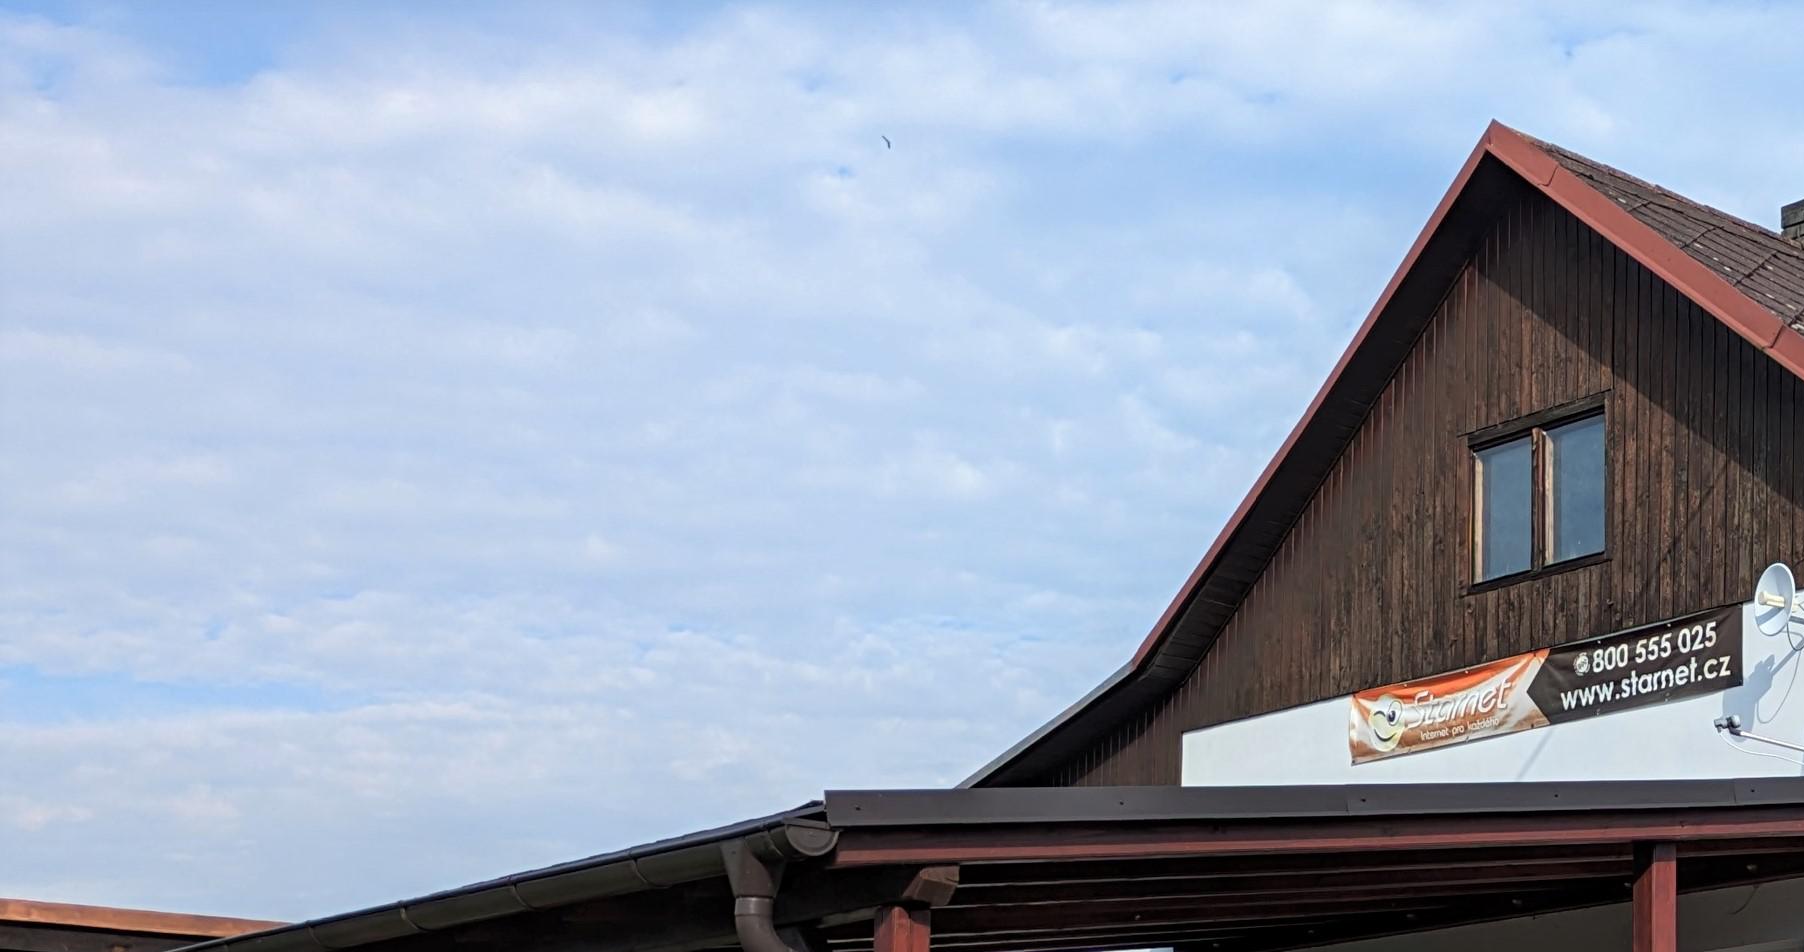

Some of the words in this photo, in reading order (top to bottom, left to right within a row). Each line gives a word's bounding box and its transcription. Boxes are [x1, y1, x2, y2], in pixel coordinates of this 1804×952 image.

[1592, 643, 1628, 674] 800
[1635, 632, 1672, 664] 555
[1677, 621, 1717, 654] 025
[1407, 678, 1512, 729] Starnet
[1560, 655, 1731, 711] www.starnet.cz
[1420, 727, 1450, 741] Internet
[1451, 725, 1465, 737] pro
